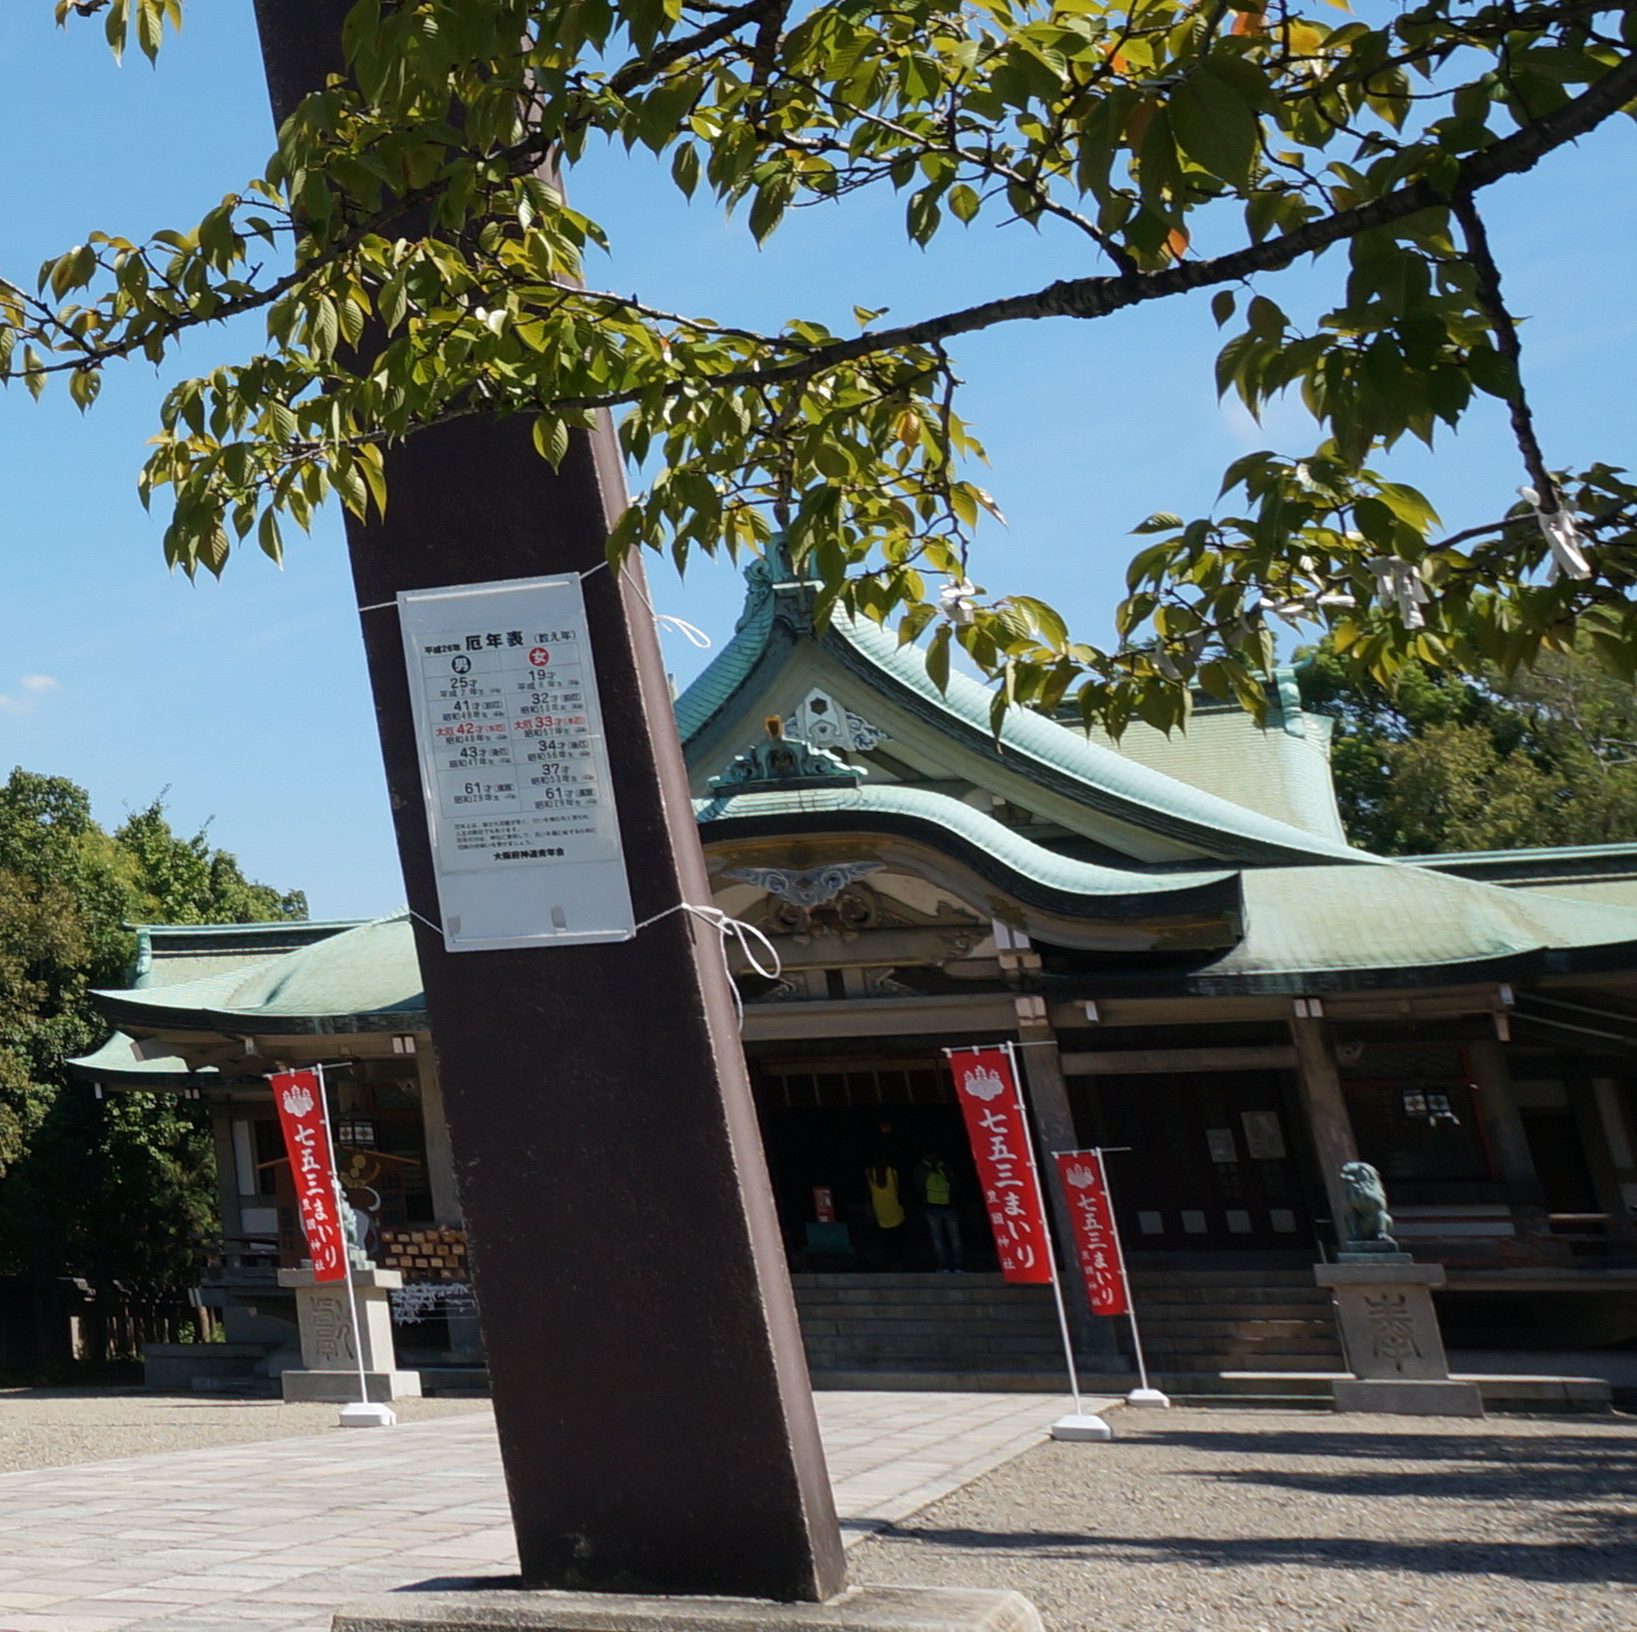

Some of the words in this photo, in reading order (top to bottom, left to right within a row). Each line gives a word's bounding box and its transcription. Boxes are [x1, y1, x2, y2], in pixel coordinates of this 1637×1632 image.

[424, 643, 462, 655] 平成26年
[465, 631, 524, 651] 厄年表
[452, 656, 471, 674] 男
[530, 648, 549, 666] 女
[450, 676, 478, 690] 25才
[528, 669, 556, 682] 19才
[542, 763, 570, 776] 37才
[294, 1124, 338, 1269] 七五三まいり
[977, 1108, 1036, 1269] 七五三まいり
[1076, 1194, 1115, 1306] 七五三まいり
